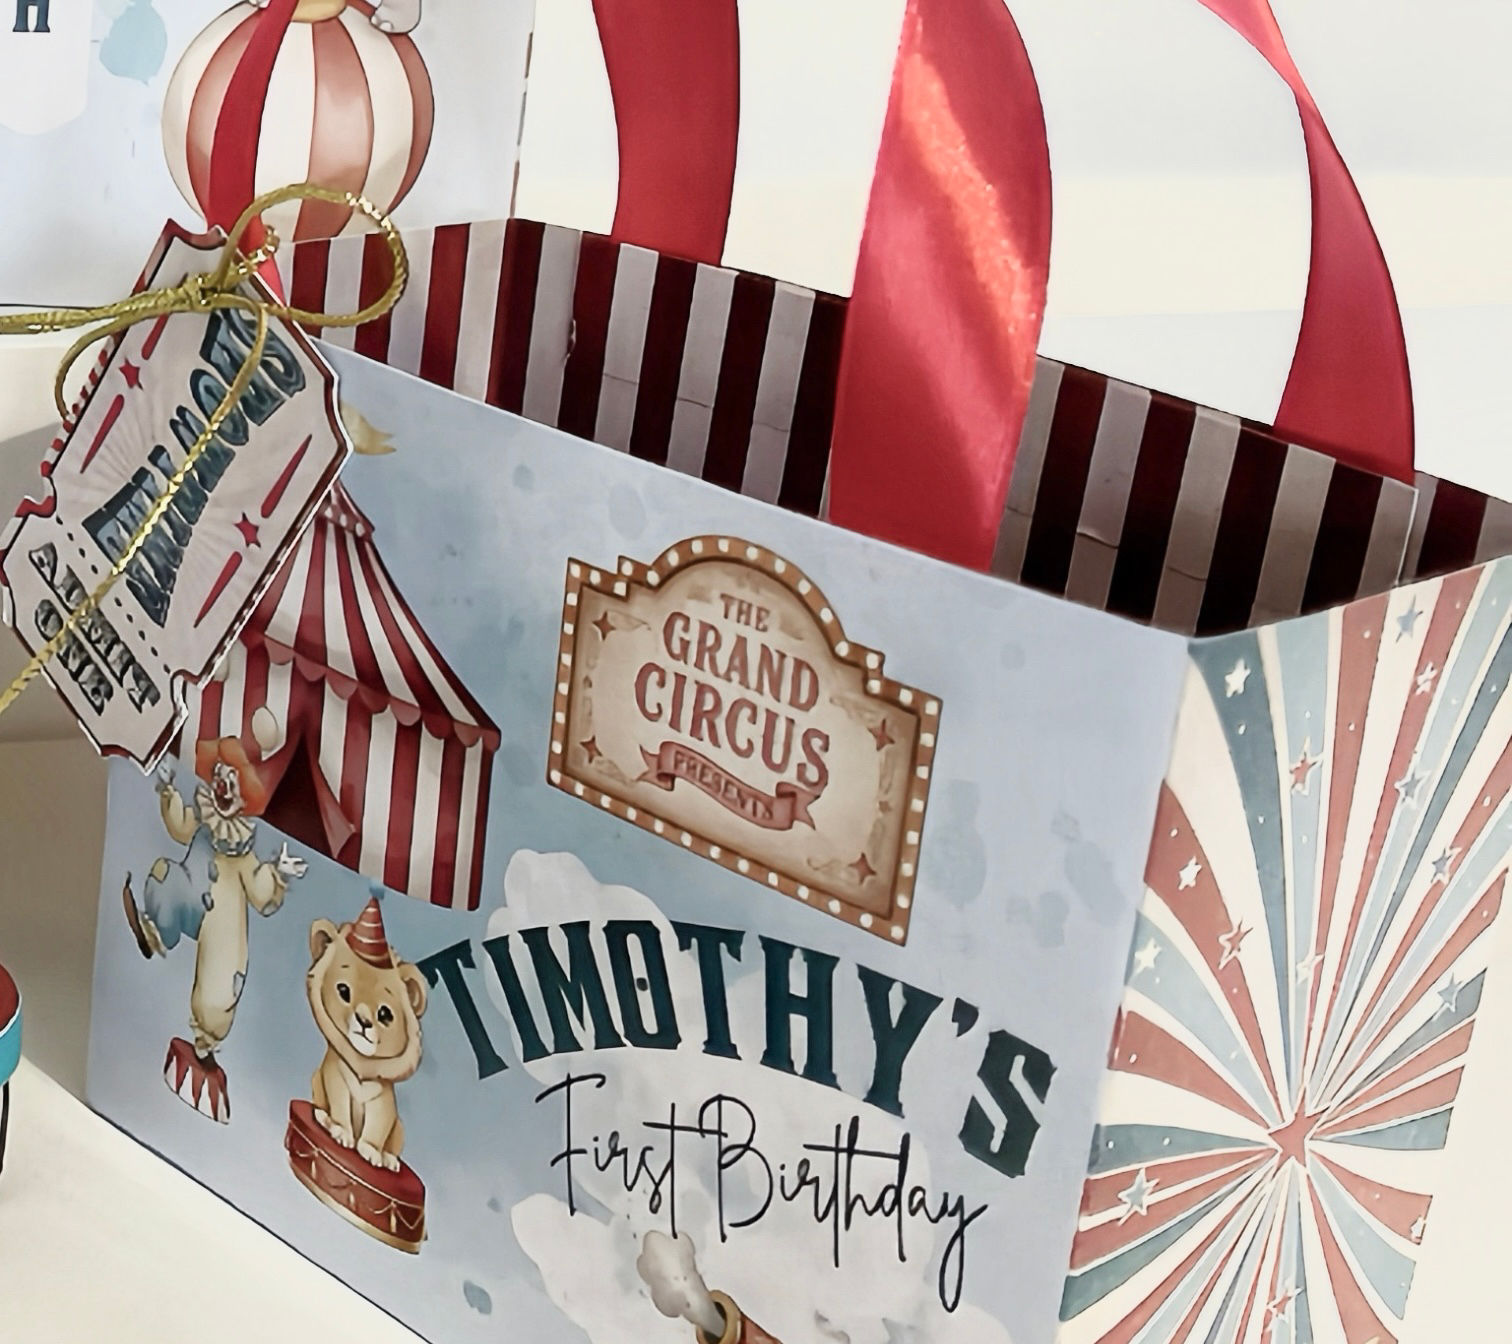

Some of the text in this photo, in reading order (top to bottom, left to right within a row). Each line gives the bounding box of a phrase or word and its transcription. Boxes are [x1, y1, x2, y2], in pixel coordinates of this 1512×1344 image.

[81, 308, 306, 628] SHOWTIME
[28, 542, 161, 714] ADMIT
[34, 598, 114, 717] ONE
[662, 611, 820, 713] GRAND
[719, 592, 771, 633] THE
[634, 661, 830, 792] CIRCUS
[672, 749, 775, 822] PRESENTS
[416, 919, 1058, 1179] TIMOTHY'S
[534, 1072, 990, 1313] First Birthday
